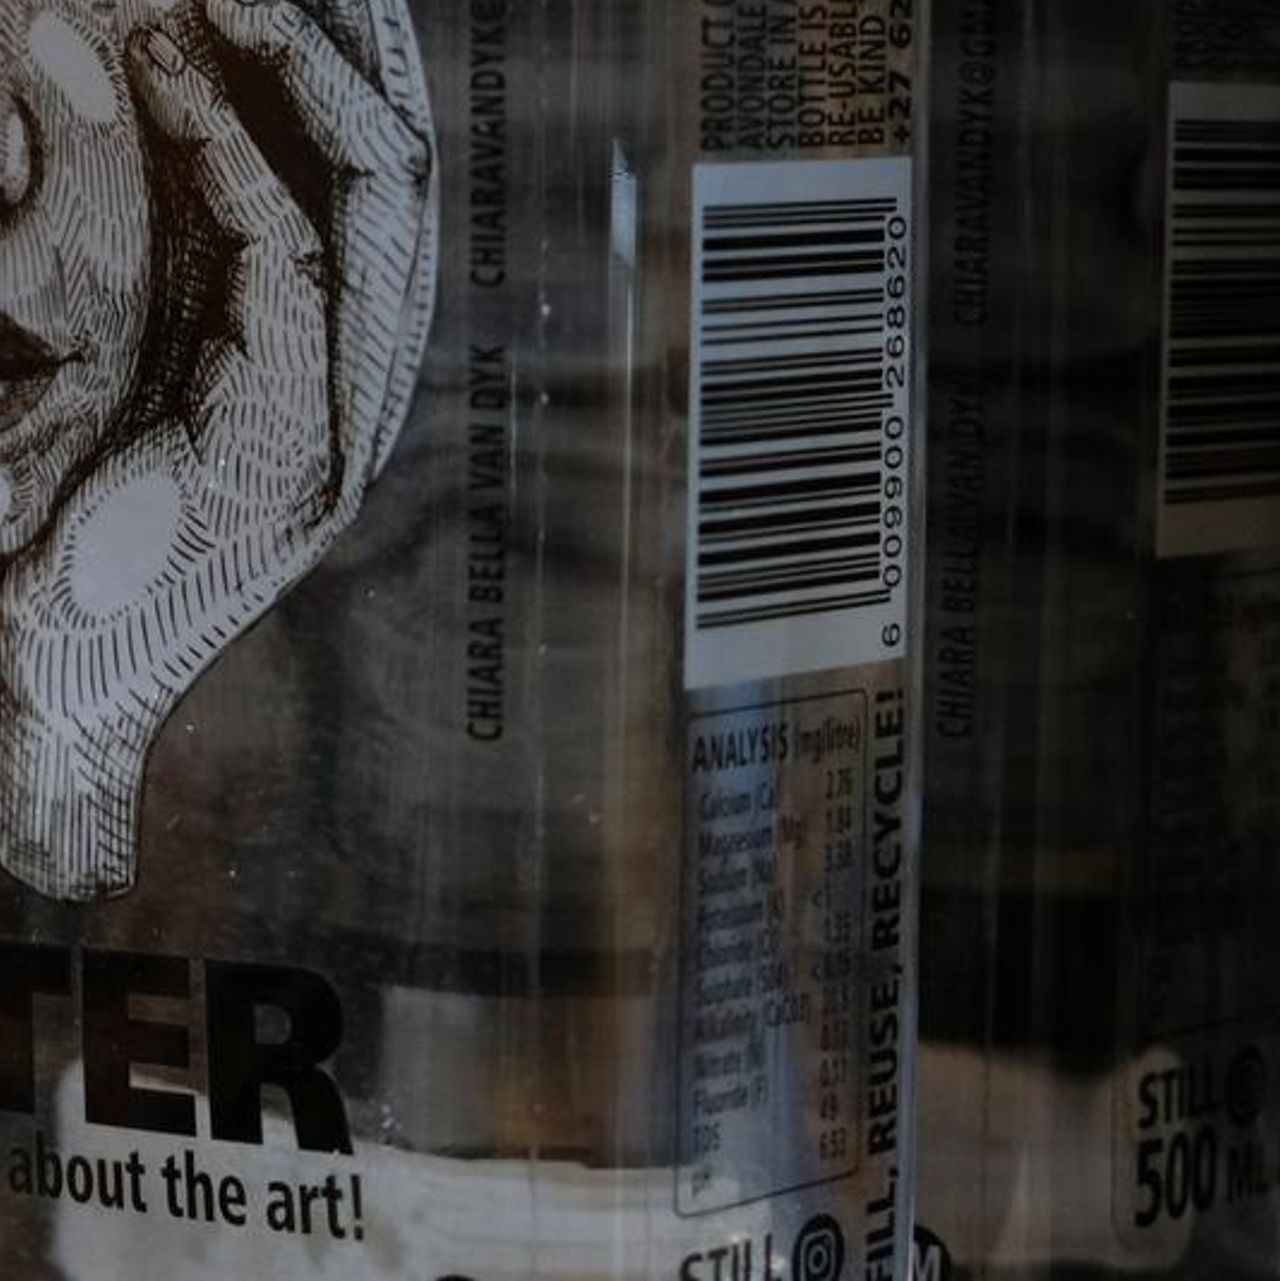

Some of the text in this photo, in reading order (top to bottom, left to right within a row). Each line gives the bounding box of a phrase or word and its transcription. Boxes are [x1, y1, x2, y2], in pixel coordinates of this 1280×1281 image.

[769, 17, 797, 44] IN
[799, 6, 827, 30] IS
[858, 15, 887, 94] KIND
[699, 17, 736, 152] PRODUCT
[737, 4, 766, 150] AVONDALE
[768, 56, 797, 150] STORE
[798, 41, 827, 148] BOTTLE
[858, 107, 885, 145] BE
[888, 70, 912, 144] +27
[465, 345, 506, 742] CHIARA BELLA VAN DYK
[881, 622, 902, 647] 6
[692, 721, 788, 773] ANALYSIS
[872, 687, 904, 952] RECYCLE!
[867, 962, 903, 1156] REUSE,
[9, 1131, 148, 1213] about
[162, 1152, 247, 1226] the
[267, 1173, 366, 1241] art!
[1135, 1123, 1218, 1228] 500
